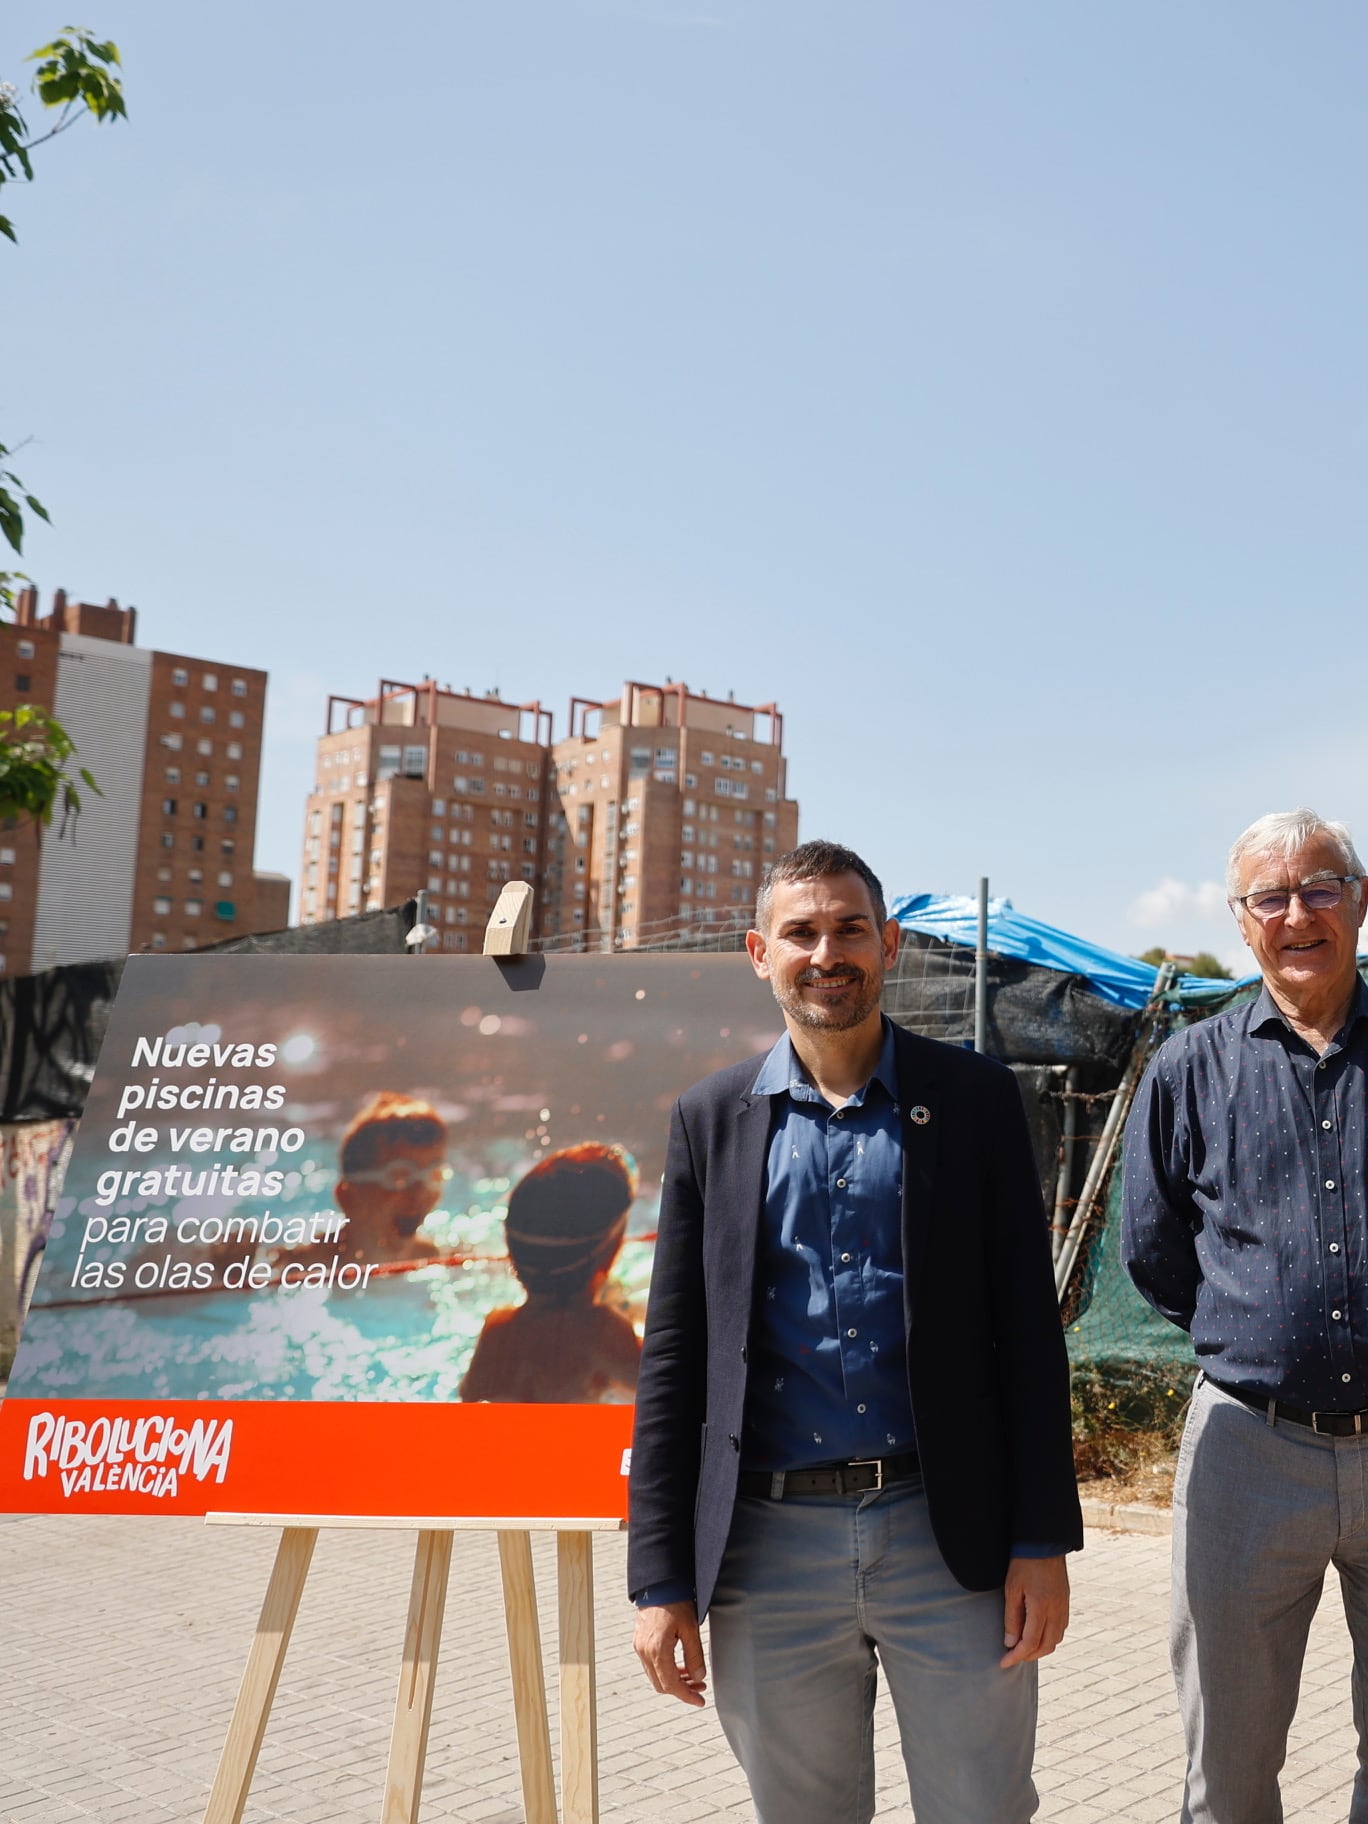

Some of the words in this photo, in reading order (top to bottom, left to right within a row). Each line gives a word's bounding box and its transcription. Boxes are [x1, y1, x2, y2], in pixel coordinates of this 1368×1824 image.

[131, 1037, 277, 1068] Nuevas
[117, 1078, 286, 1119] piscinas
[109, 1121, 158, 1152] de
[169, 1127, 304, 1152] verano
[95, 1163, 284, 1206] gratuitas
[81, 1216, 167, 1252] para
[177, 1211, 350, 1243] combatir
[71, 1253, 126, 1288] las
[135, 1255, 214, 1288] olas
[223, 1256, 272, 1288] de
[281, 1255, 379, 1289] calor
